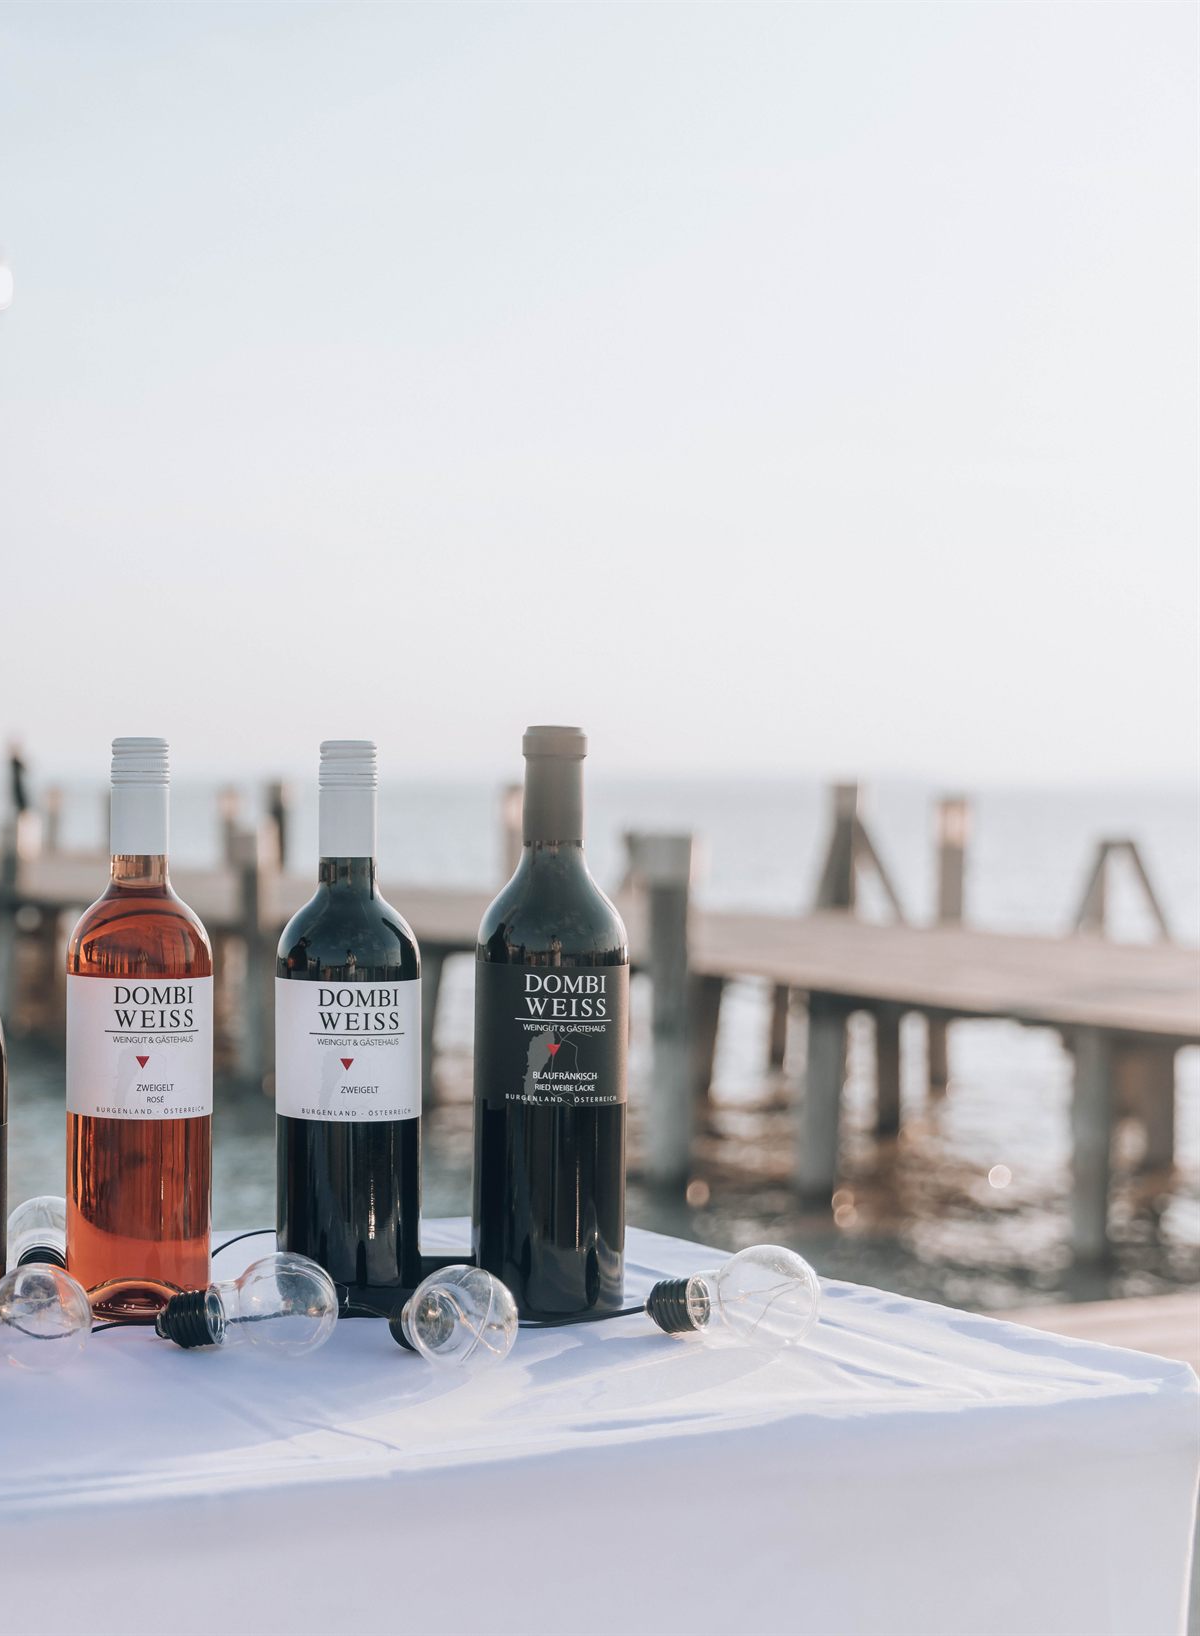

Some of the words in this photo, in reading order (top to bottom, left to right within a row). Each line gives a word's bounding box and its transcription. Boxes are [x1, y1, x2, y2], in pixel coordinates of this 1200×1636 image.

[524, 974, 607, 994] DOMBI
[113, 985, 193, 1005] DOMBI
[318, 988, 399, 1008] DOMBI
[525, 997, 606, 1017] WEISS
[114, 1009, 193, 1028] WEISS
[318, 1012, 399, 1031] WEISS
[523, 1024, 558, 1032] WEINGUT
[566, 1024, 606, 1033] GÄSTEHAUS
[113, 1036, 147, 1044] WEINGUT
[155, 1035, 194, 1044] GÄSTEHAUS
[317, 1038, 351, 1046] WEINGUT
[359, 1038, 399, 1046] GÄSTEHAUS
[532, 1071, 598, 1080] BLAUFRÄNKISCH
[136, 1083, 175, 1092] ZWEIGELT
[340, 1086, 379, 1094] ZWEIGELT
[574, 1084, 595, 1092] LACKE
[146, 1095, 164, 1103] ROSÉ
[505, 1093, 563, 1103] BURGENLAND
[574, 1095, 617, 1103] ÖSTERREICH
[96, 1106, 152, 1115] BURGENLAND
[164, 1106, 205, 1114] ÖSTERREICH
[301, 1108, 357, 1116] BURGENLAND
[368, 1108, 412, 1116] ÖSTERREICH
